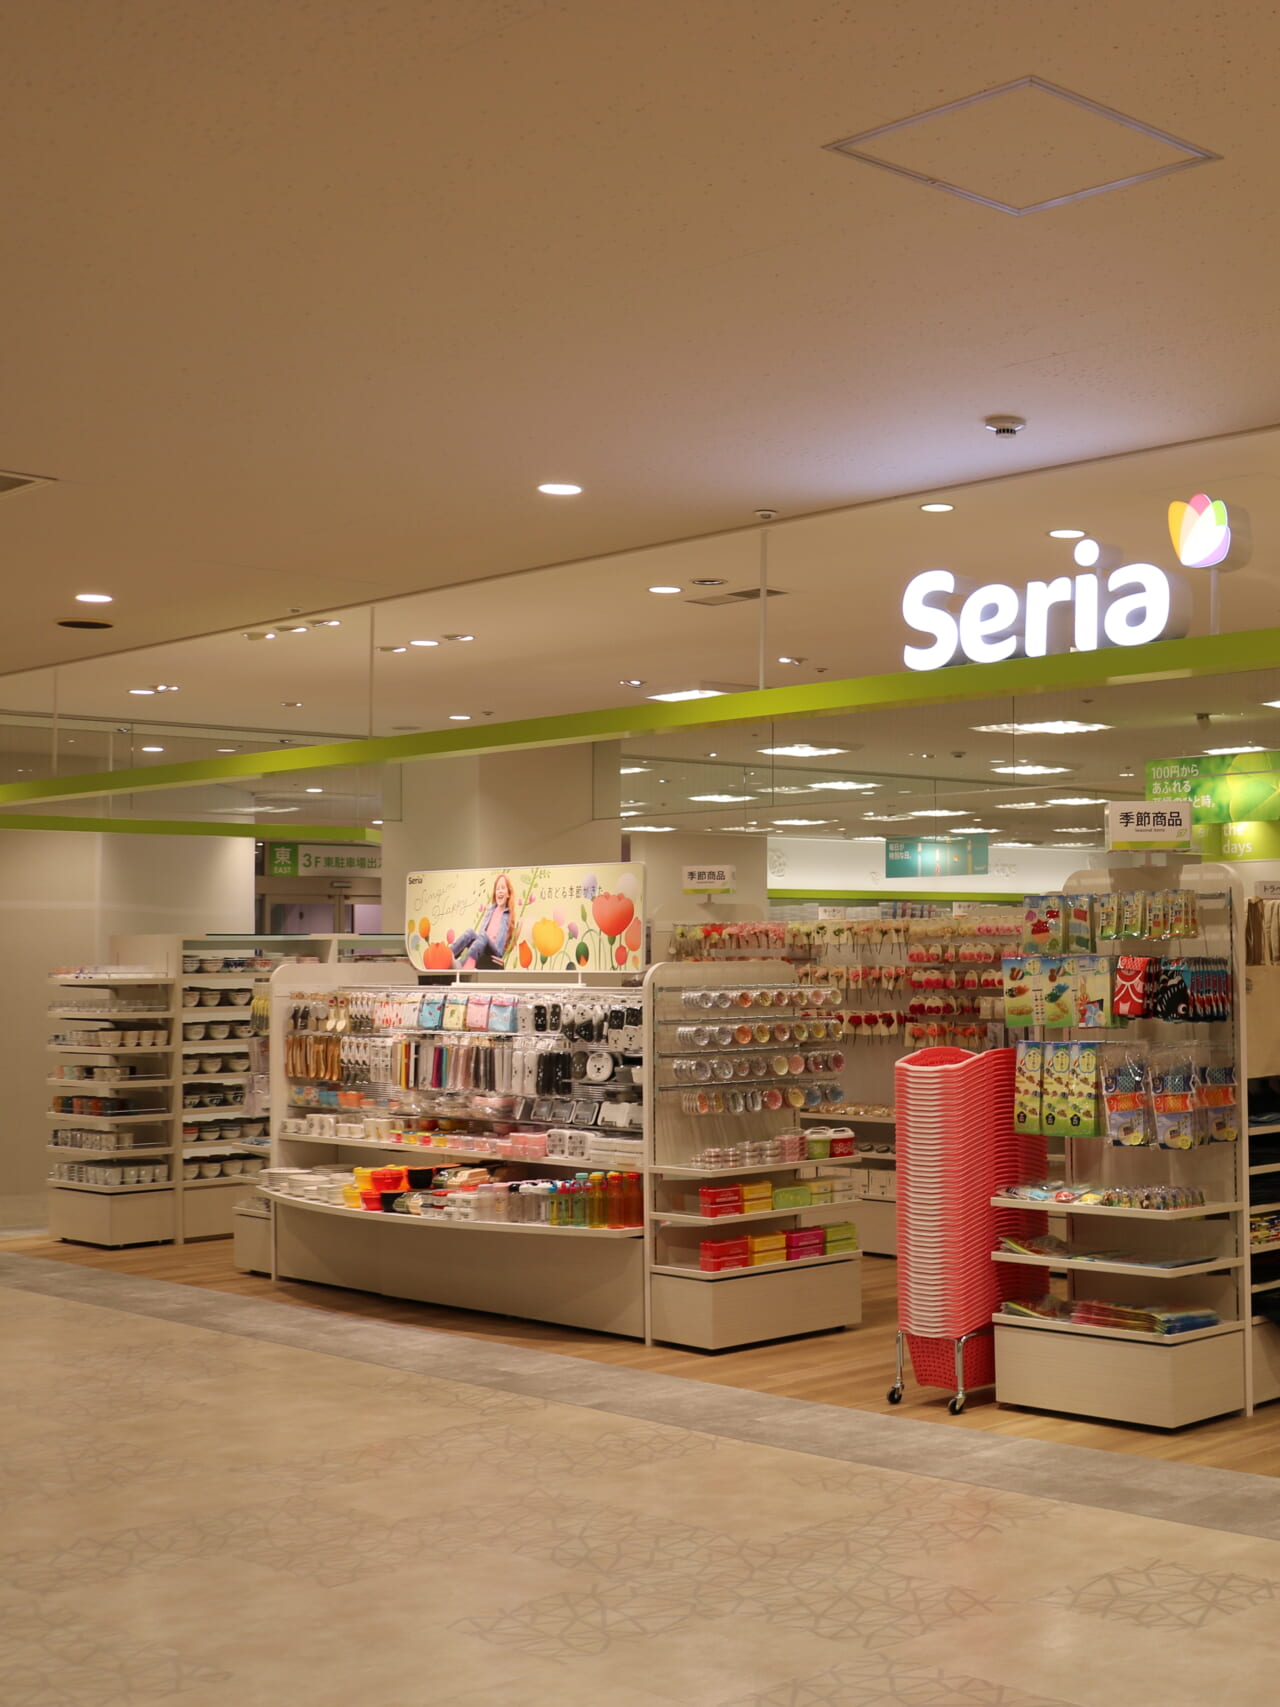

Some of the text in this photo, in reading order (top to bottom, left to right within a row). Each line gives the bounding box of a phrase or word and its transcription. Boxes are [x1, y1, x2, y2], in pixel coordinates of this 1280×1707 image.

[902, 539, 1170, 671] Seria
[1151, 764, 1200, 779] 100円から
[1151, 780, 1192, 795] あふれる
[1119, 811, 1182, 828] 季節商品
[273, 847, 292, 865] 東
[1222, 840, 1253, 857] days
[687, 870, 726, 881] 季節商品
